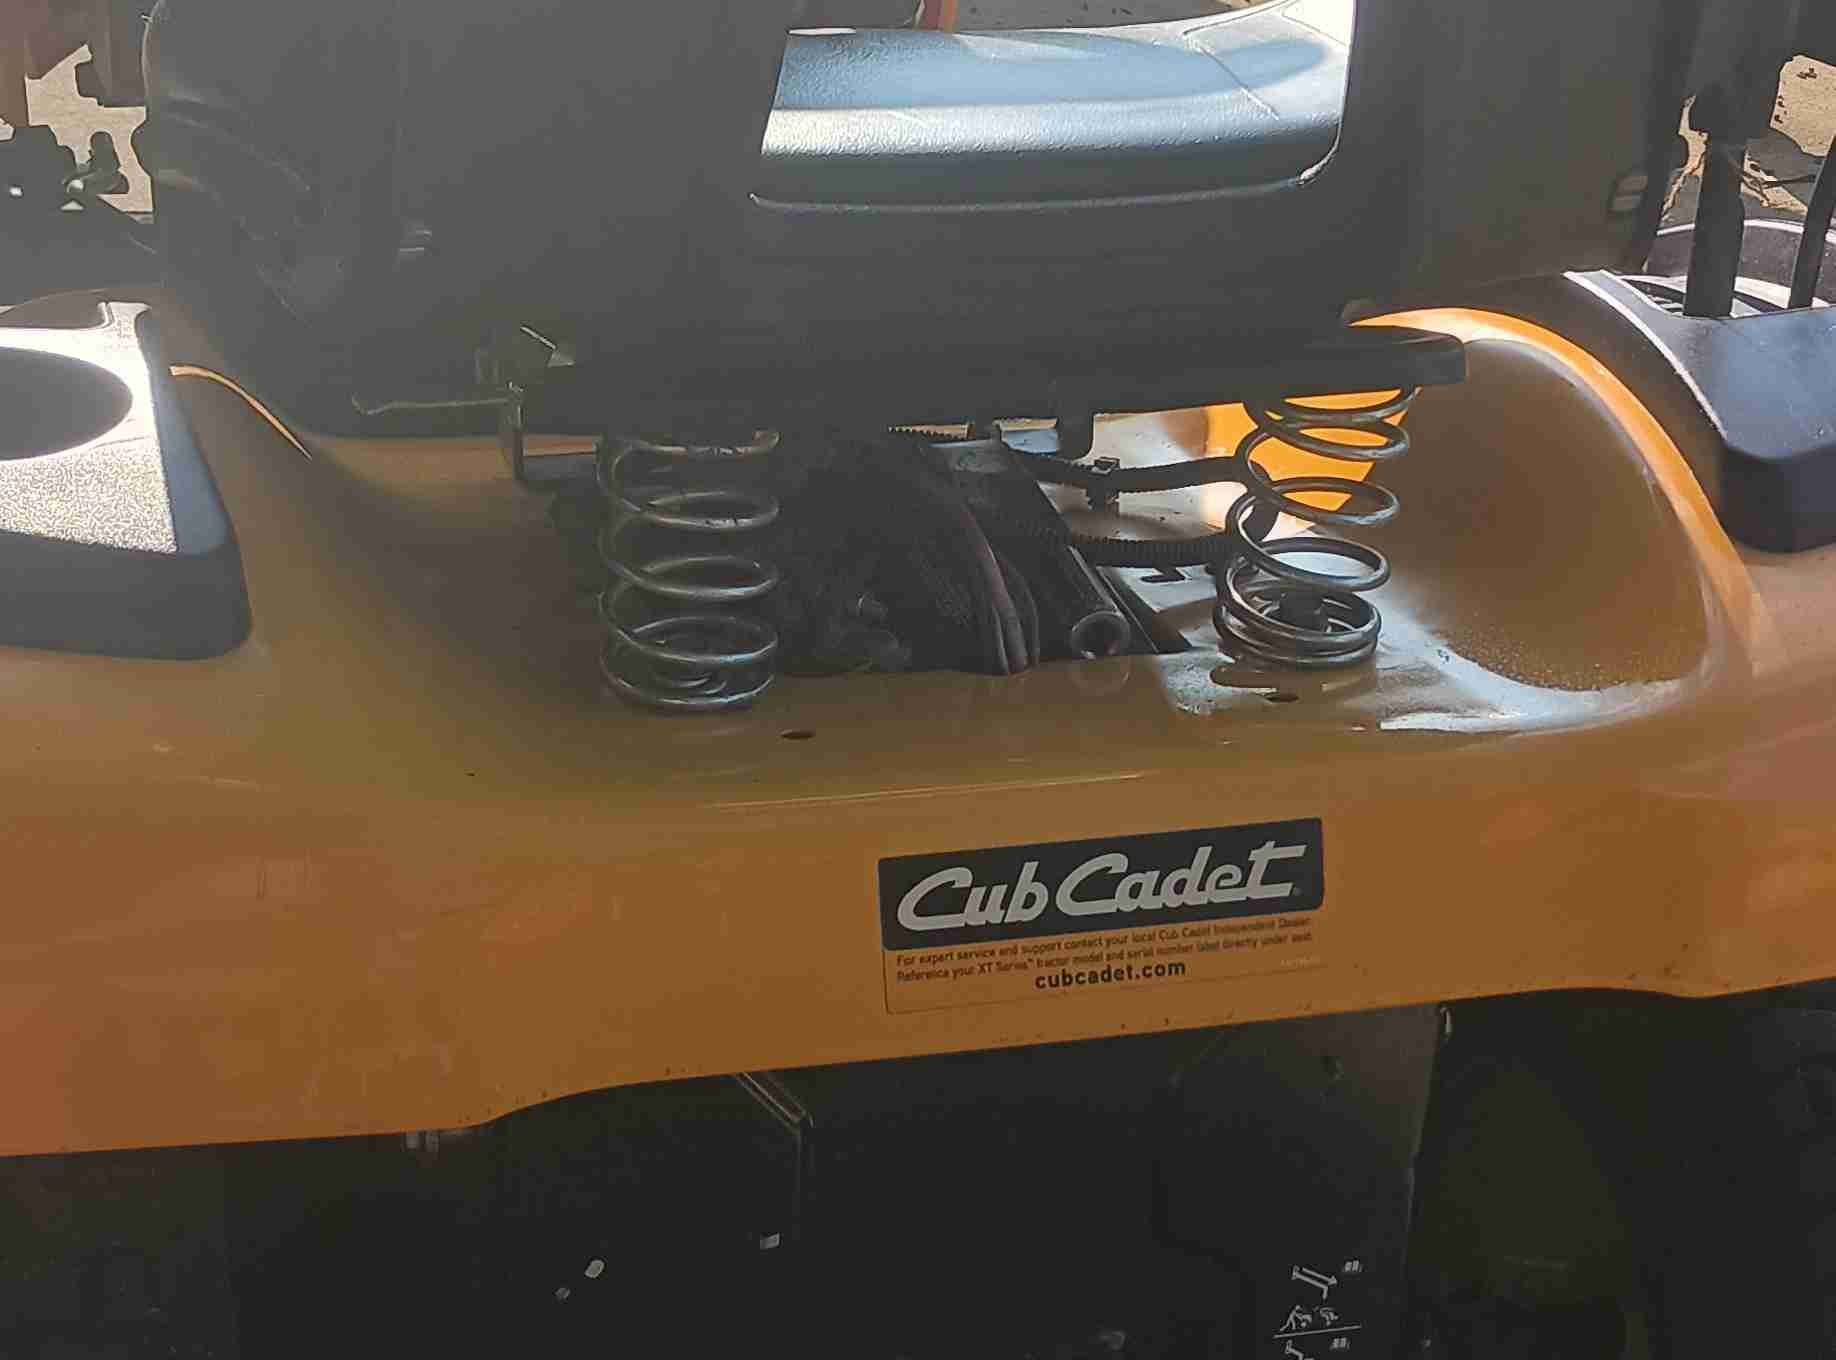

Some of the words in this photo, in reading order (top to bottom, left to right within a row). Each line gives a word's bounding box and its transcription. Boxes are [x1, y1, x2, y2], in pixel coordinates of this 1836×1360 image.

[897, 861, 1049, 931] Cub
[1056, 841, 1307, 916] Cadet
[897, 954, 915, 966] For
[919, 950, 954, 966] expert
[957, 947, 996, 959] service
[999, 944, 1019, 957] and
[1021, 941, 1062, 956] support
[1064, 936, 1103, 951] contact
[1104, 934, 1129, 949] your
[1132, 930, 1157, 944] local
[1159, 928, 1179, 941] Cub
[1182, 923, 1211, 937] Cadet
[896, 968, 950, 982] Reference
[952, 967, 975, 981] your
[978, 962, 993, 975] XT
[1073, 950, 1104, 965] model
[1105, 948, 1125, 962] and
[1034, 961, 1186, 990] cubcadet.com
